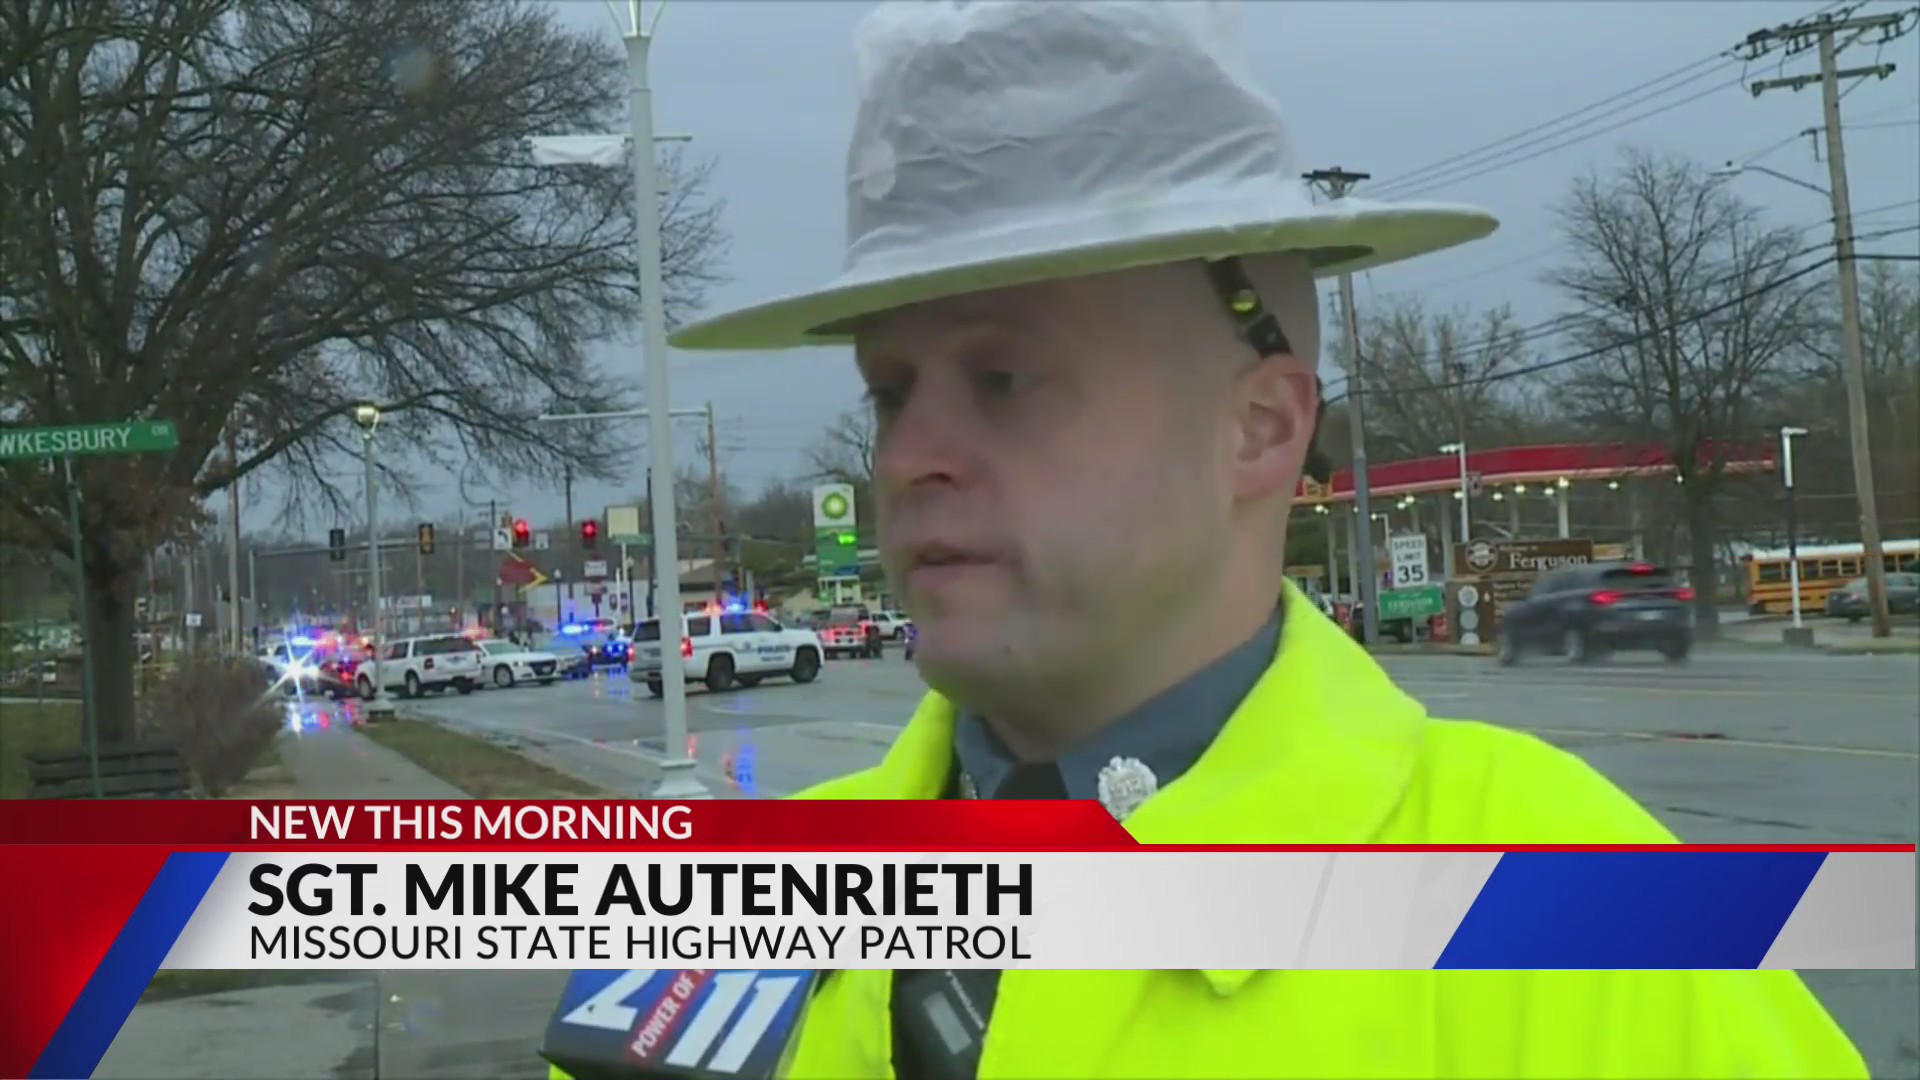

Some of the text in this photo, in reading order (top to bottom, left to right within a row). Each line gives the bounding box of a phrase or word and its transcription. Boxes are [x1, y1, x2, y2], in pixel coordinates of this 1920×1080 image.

[152, 425, 169, 436] DR
[1394, 540, 1425, 551] SPEED
[1509, 551, 1590, 571] Ferguson
[1398, 564, 1424, 584] 35
[631, 971, 695, 1058] POWER OF
